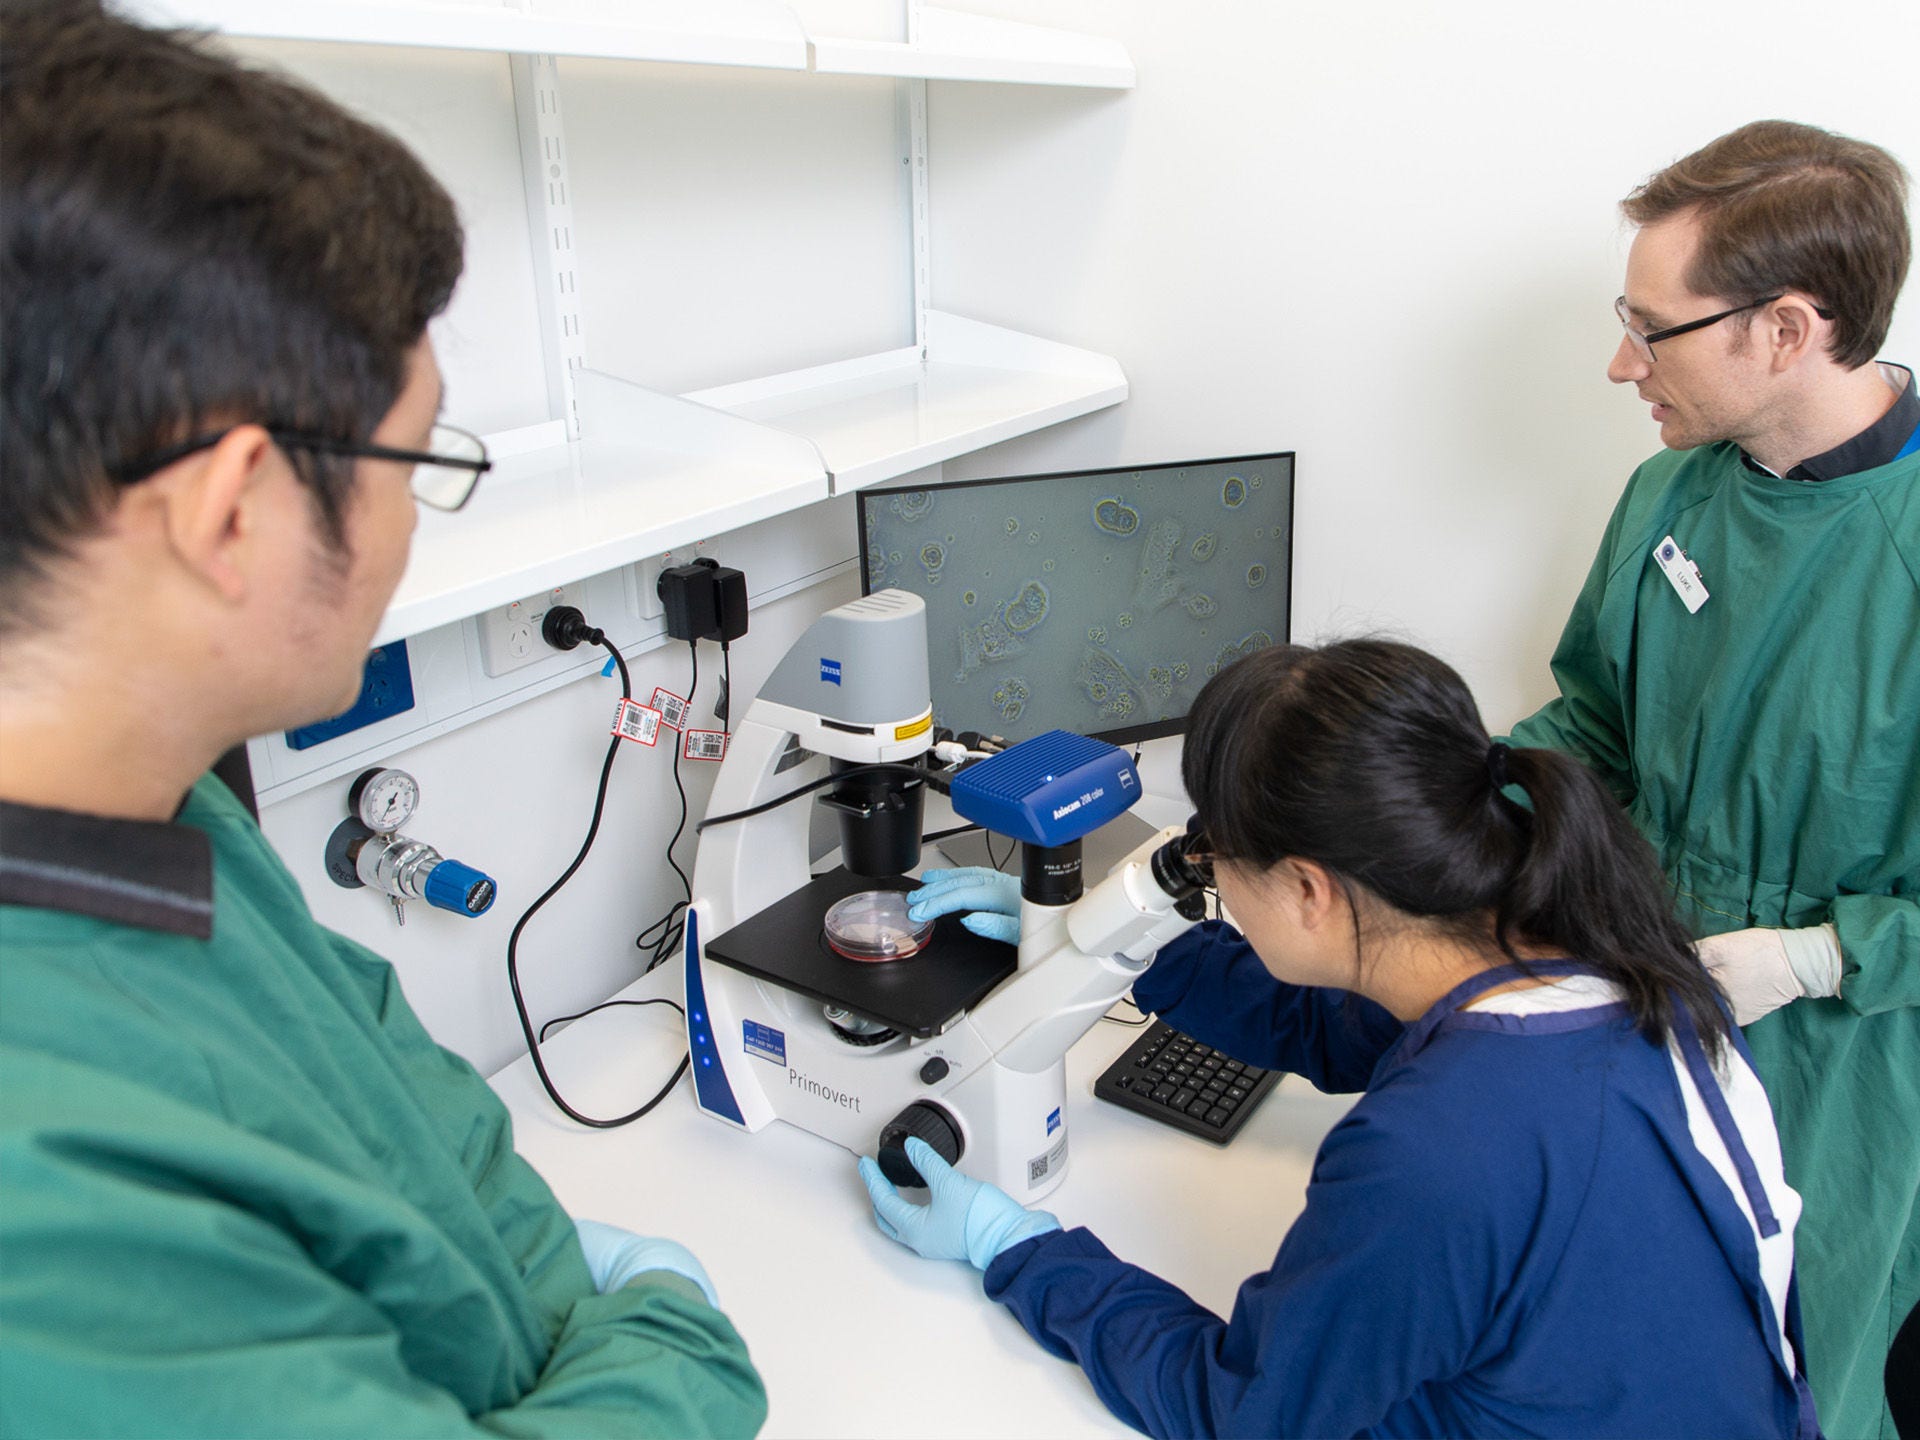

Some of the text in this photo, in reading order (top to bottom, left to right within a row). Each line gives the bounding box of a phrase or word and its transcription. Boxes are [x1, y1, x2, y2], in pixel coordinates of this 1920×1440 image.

[1676, 571, 1693, 592] LUKE
[820, 664, 841, 676] ZEISS
[1053, 801, 1081, 820] Axiocam
[789, 1069, 861, 1113] Primovert
